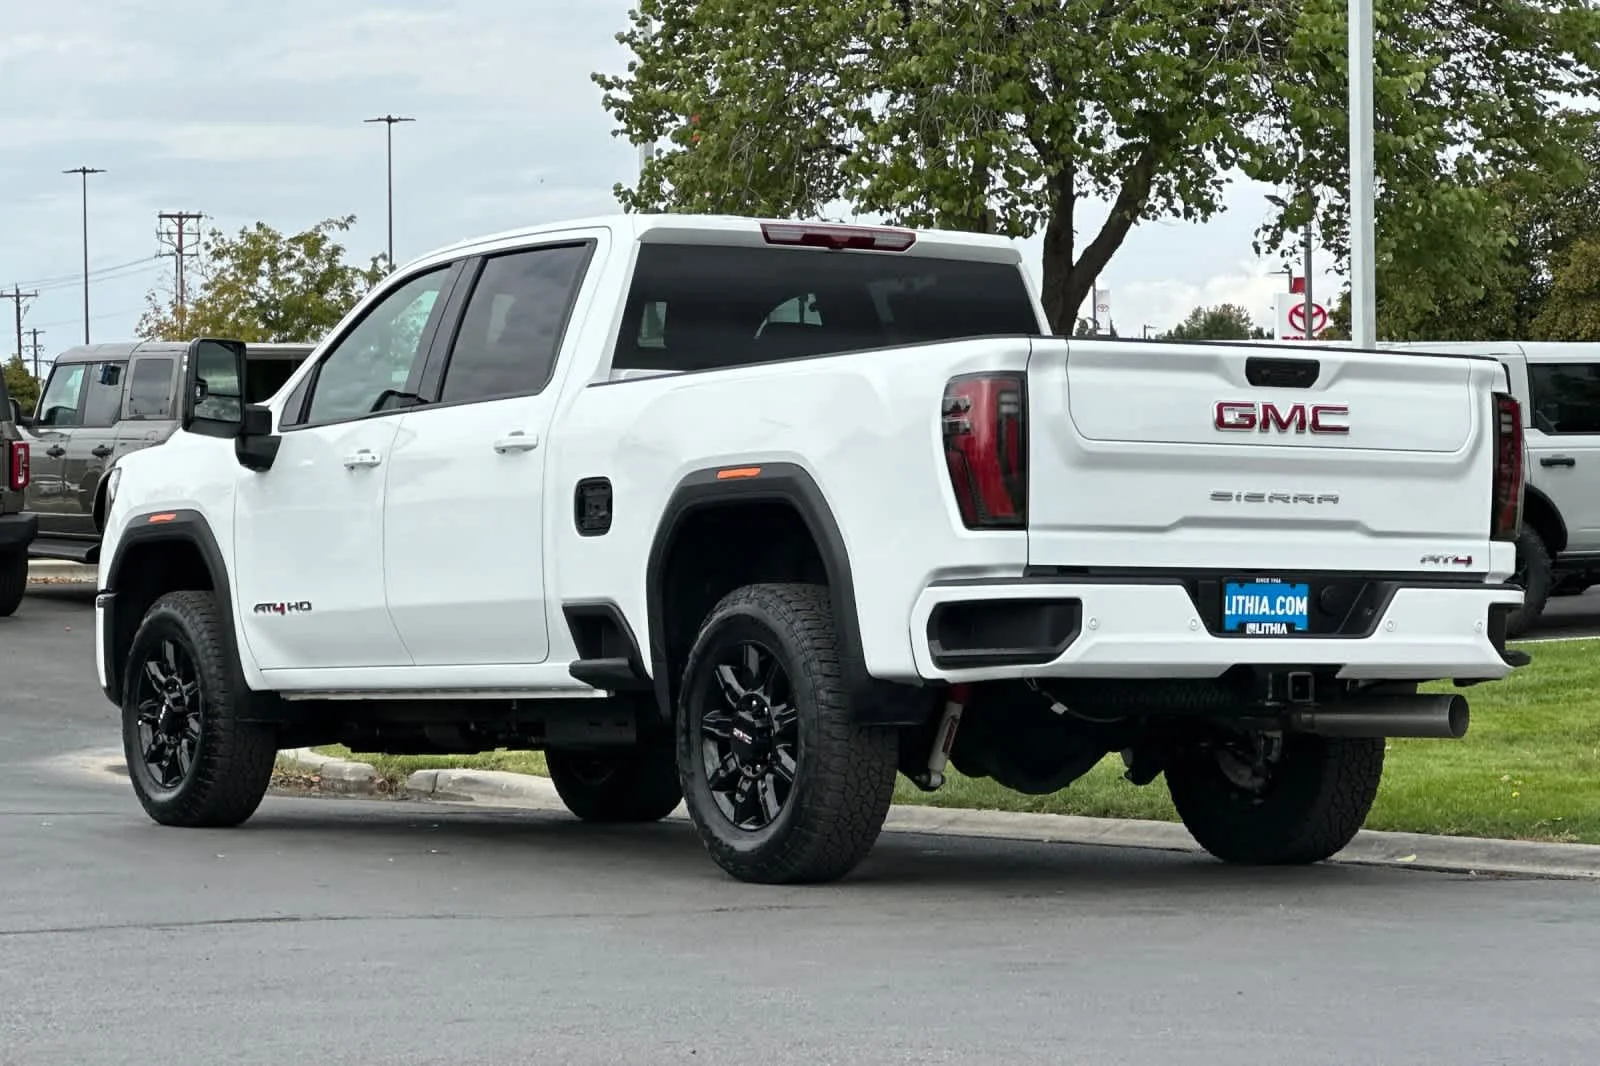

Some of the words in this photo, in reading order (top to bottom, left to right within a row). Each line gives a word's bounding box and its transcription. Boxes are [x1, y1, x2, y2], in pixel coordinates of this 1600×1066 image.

[1214, 400, 1350, 434] GMC
[1210, 491, 1340, 504] SIERRA
[1420, 554, 1472, 568] AT4
[1224, 595, 1308, 616] LITHIA.COM
[1255, 622, 1288, 634] LITHIA
